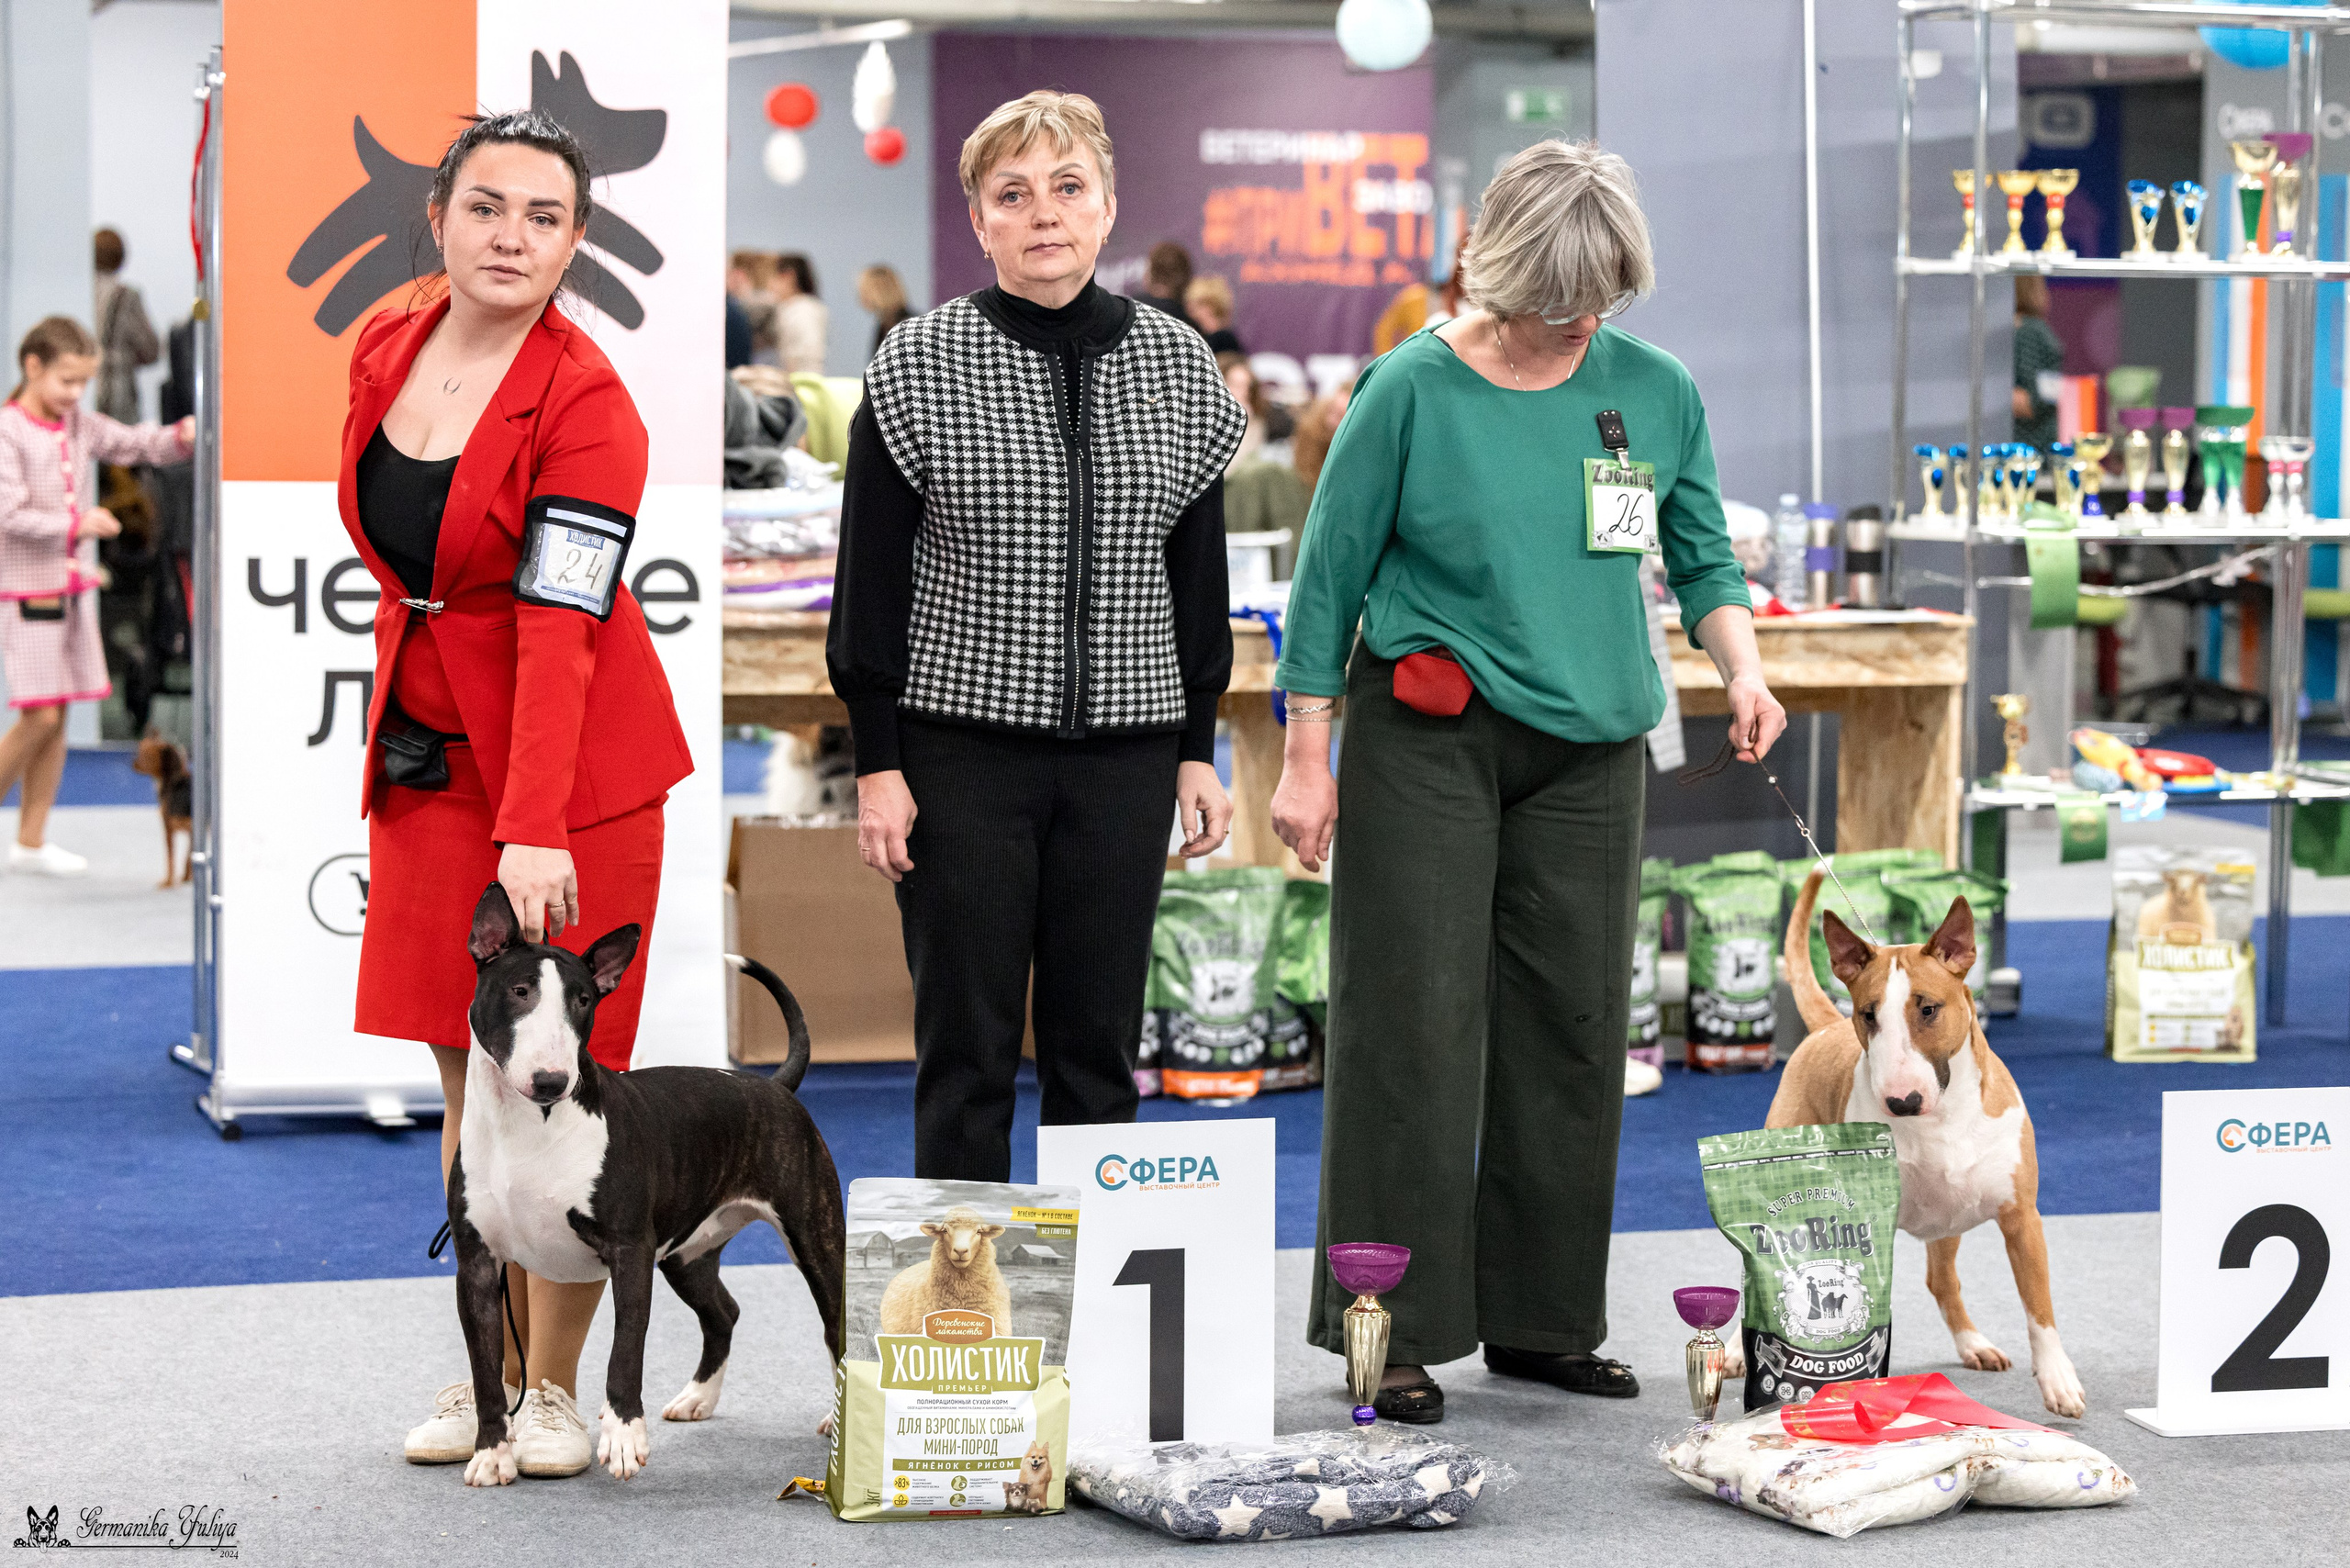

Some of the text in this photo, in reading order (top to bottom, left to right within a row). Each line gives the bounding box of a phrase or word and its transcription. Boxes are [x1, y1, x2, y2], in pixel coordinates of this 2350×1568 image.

[1608, 494, 1644, 536] 26
[557, 548, 603, 590] 24
[2216, 1118, 2332, 1153] СФЕРА
[1095, 1154, 1220, 1191] СФЕРА
[1139, 1182, 1220, 1191] ВЫСТАВОЧНЫЙ ЦЕНТР
[1767, 1187, 1856, 1217] SUPER PREMIUM
[1750, 1215, 1874, 1257] ZooRing
[2211, 1204, 2331, 1393] 2
[933, 1317, 985, 1330] Деревенские
[935, 1327, 983, 1336] лакомства
[1112, 1248, 1186, 1443] 1
[890, 1343, 1032, 1384] ХОЛИСТИК
[1789, 1352, 1864, 1374] DOG FOOD
[897, 1417, 1025, 1436] ДЛЯ ВЗРОСЛЫХ СОБАК
[923, 1438, 999, 1457] МИНИ-ПОРОД
[908, 1461, 1014, 1470] ЯГНЁНОК С РИСОМ
